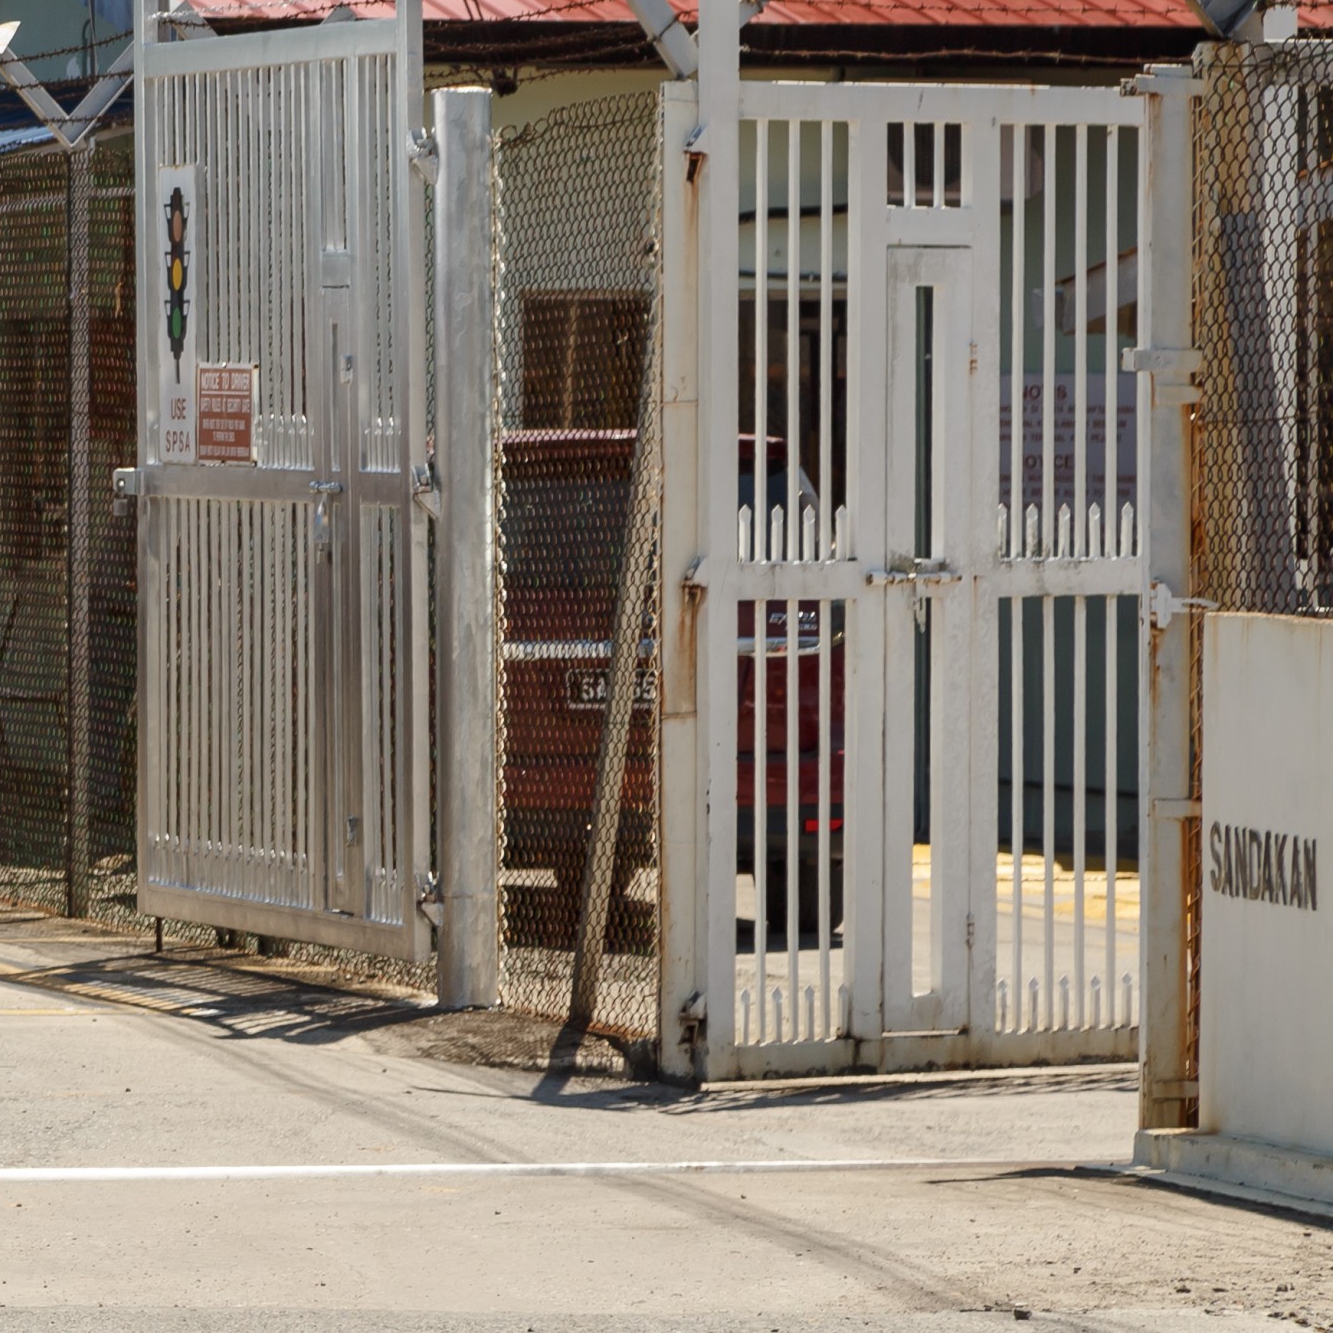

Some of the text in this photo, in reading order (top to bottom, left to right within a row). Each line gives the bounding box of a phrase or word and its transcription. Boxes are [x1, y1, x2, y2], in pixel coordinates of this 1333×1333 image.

[170, 397, 187, 420] USE
[165, 430, 191, 453] SPSA
[1209, 820, 1318, 912] SANDAKAN
